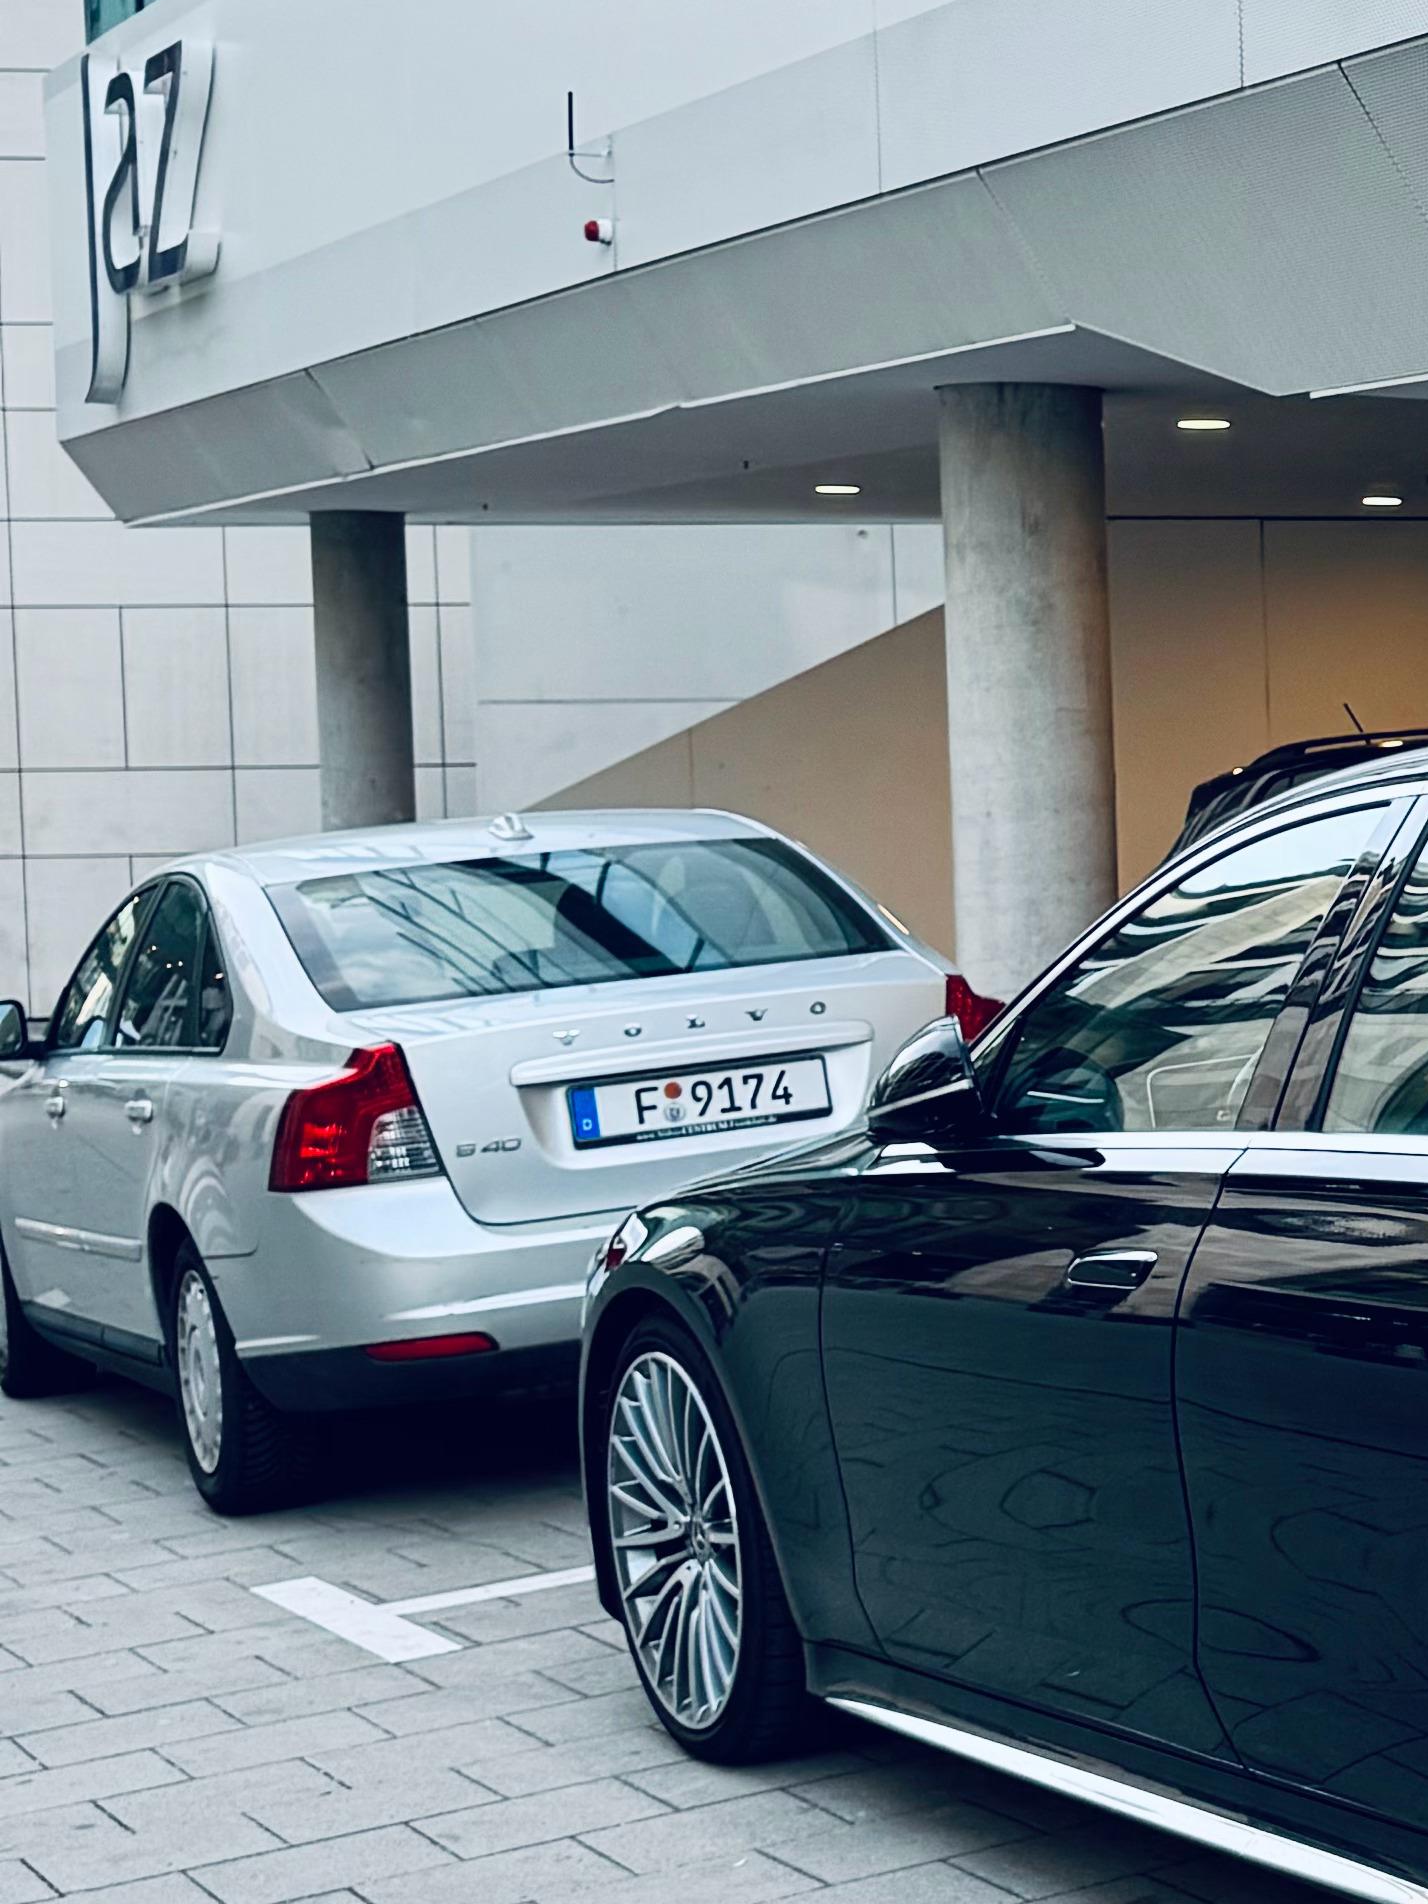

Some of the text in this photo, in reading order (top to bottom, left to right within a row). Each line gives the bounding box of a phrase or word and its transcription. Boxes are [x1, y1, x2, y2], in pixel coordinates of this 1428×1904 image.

[553, 1000, 828, 1046] VOLVO
[635, 1070, 794, 1125] F 9174
[582, 1118, 593, 1131] D
